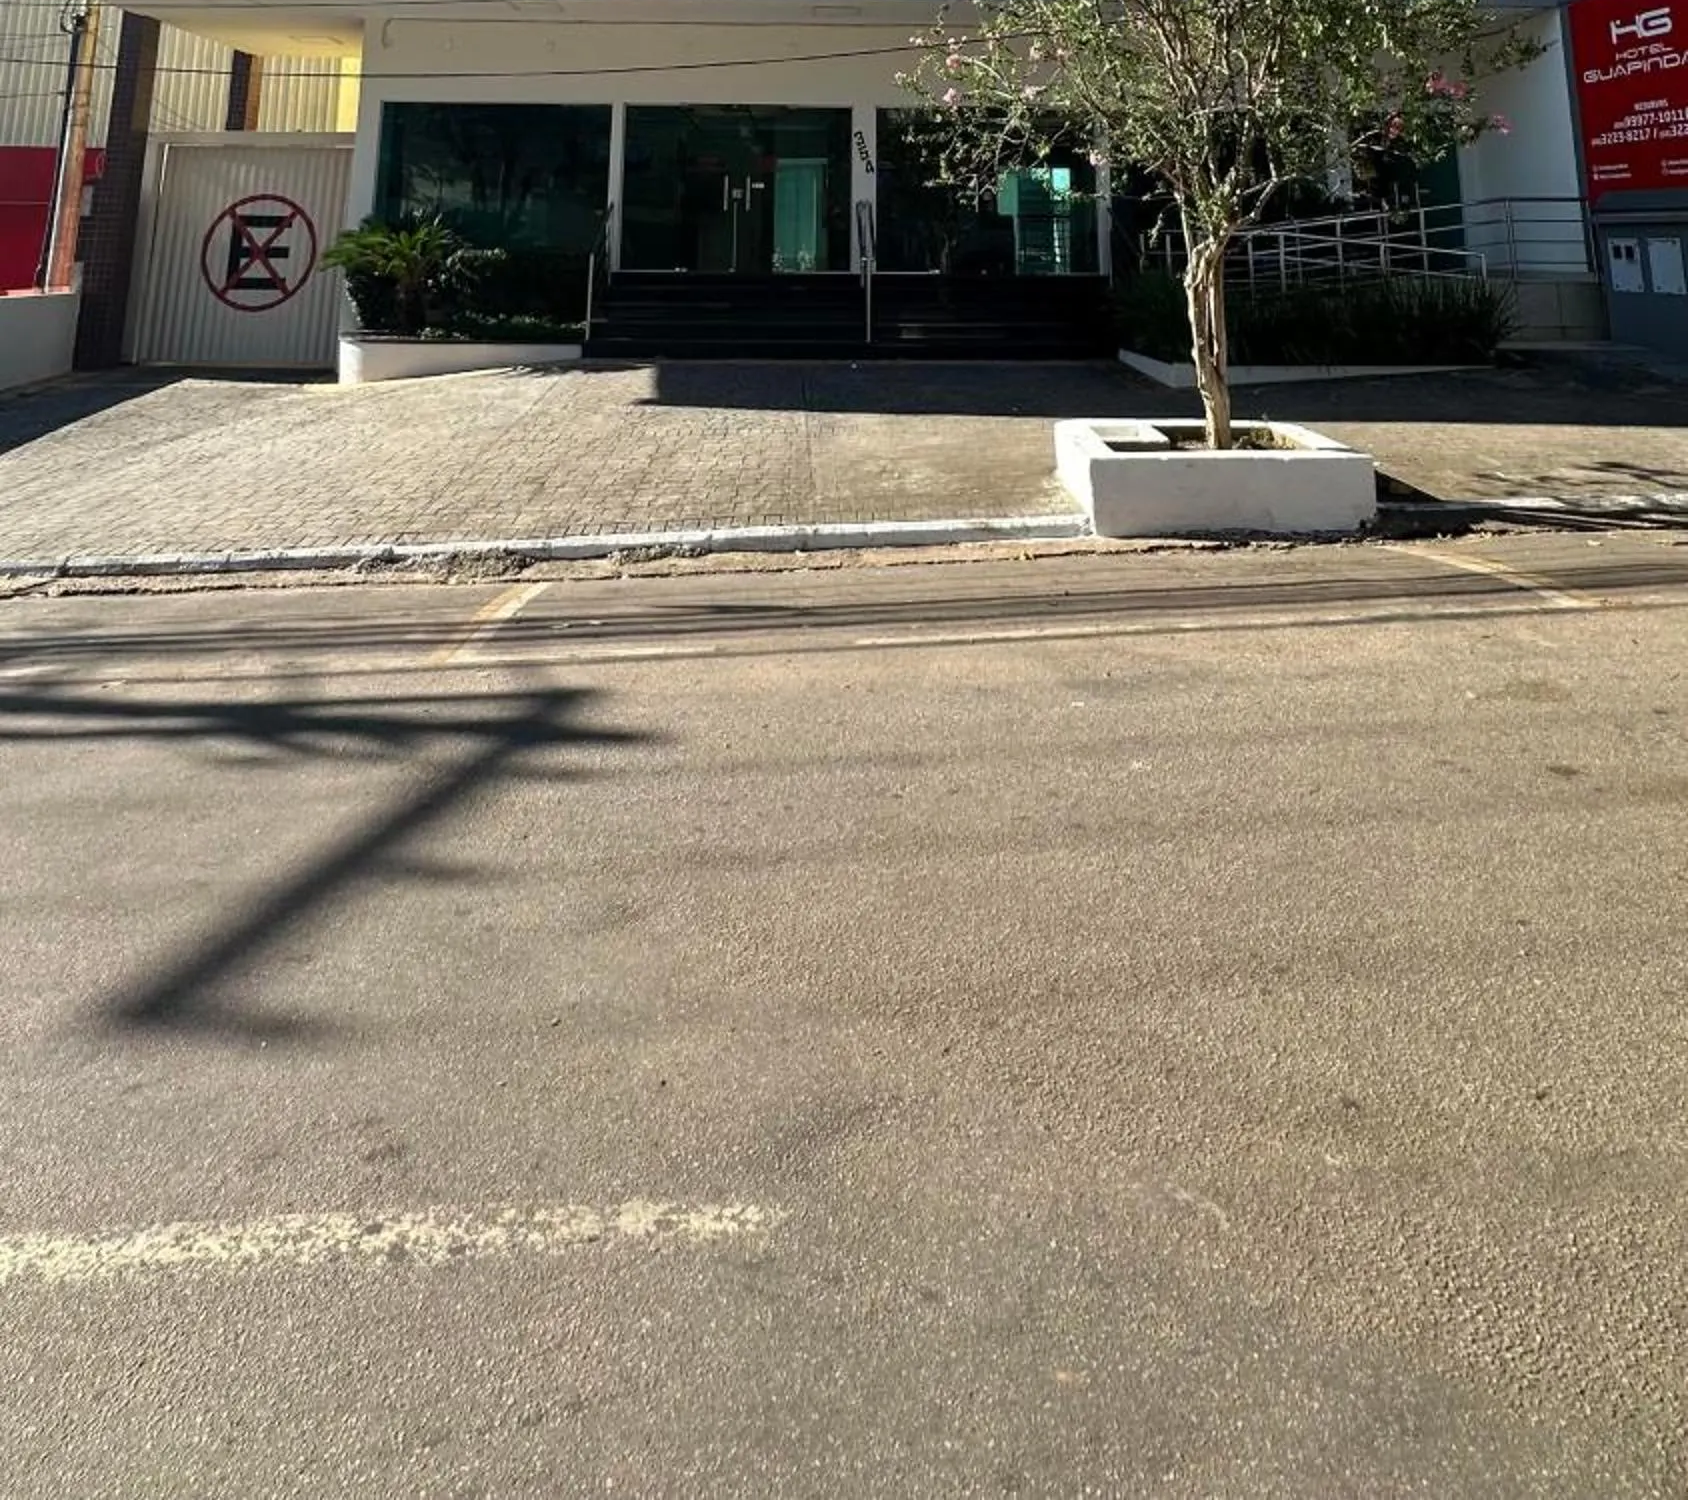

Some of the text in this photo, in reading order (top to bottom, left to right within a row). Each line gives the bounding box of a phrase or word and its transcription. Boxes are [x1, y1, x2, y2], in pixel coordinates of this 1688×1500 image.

[1609, 6, 1673, 45] HG
[1615, 41, 1674, 61] HOTEL
[225, 214, 293, 290] E
